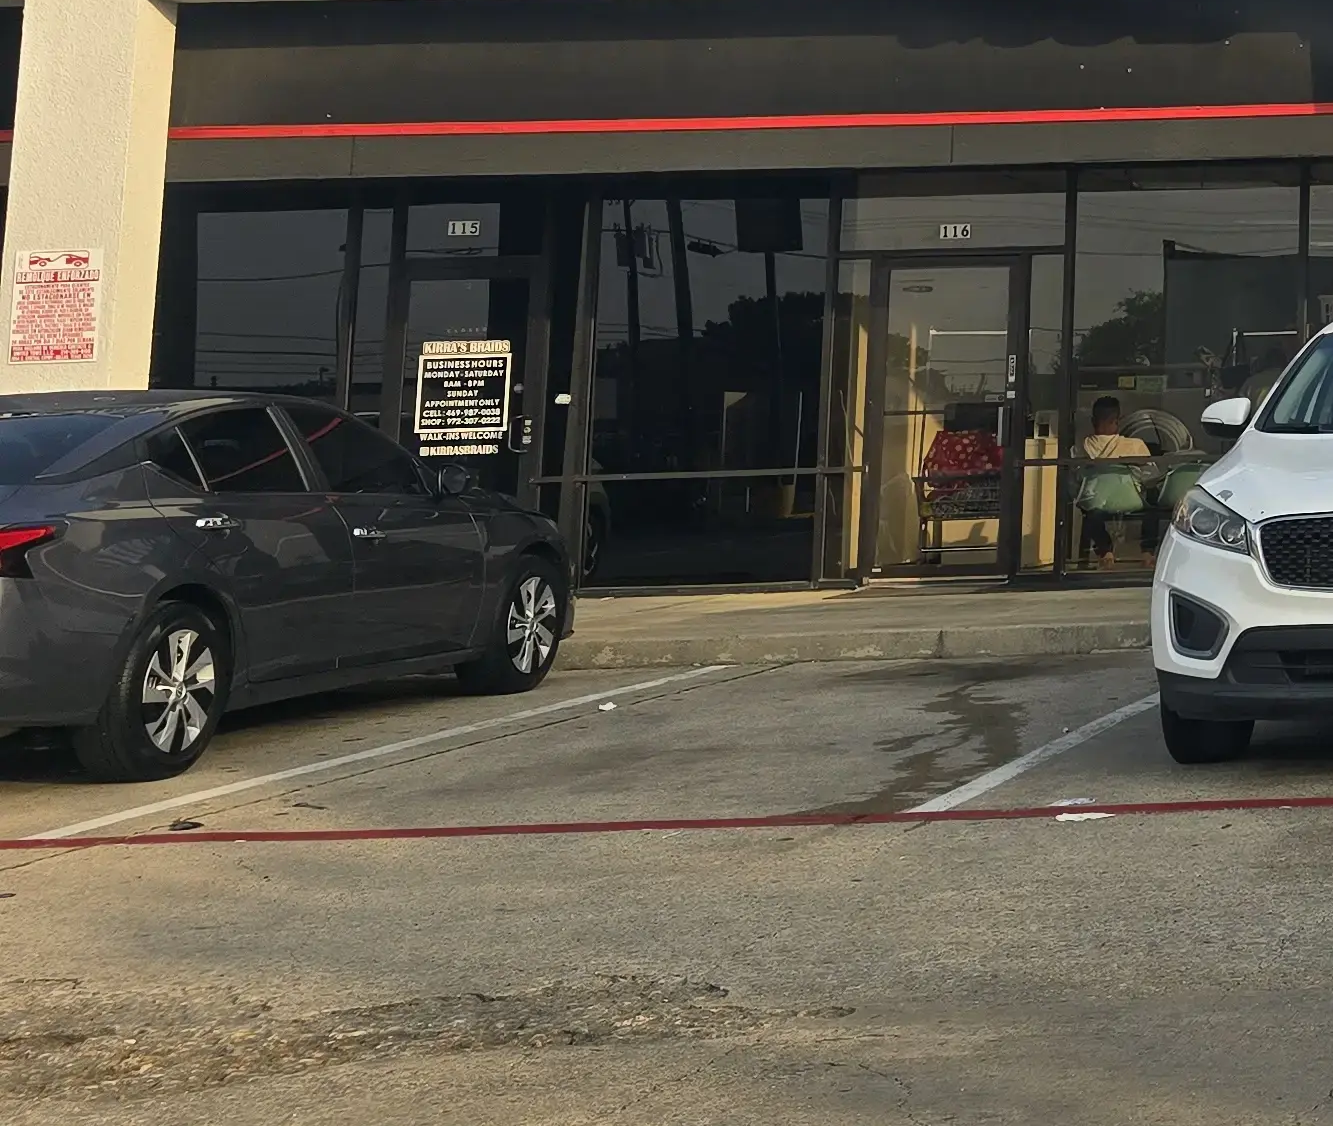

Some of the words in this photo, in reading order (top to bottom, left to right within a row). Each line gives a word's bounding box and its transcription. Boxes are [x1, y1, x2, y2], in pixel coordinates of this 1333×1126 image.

[451, 223, 478, 234] 115
[943, 225, 969, 237] 116
[424, 341, 467, 354] KIRRA'S
[470, 340, 509, 353] BRAIDS
[426, 360, 470, 369] BUSINESS
[471, 359, 504, 368] HOURS
[420, 432, 460, 441] WALK-INS
[460, 432, 503, 440] WELCOME
[429, 445, 499, 456] KIRRASBRAIDS
